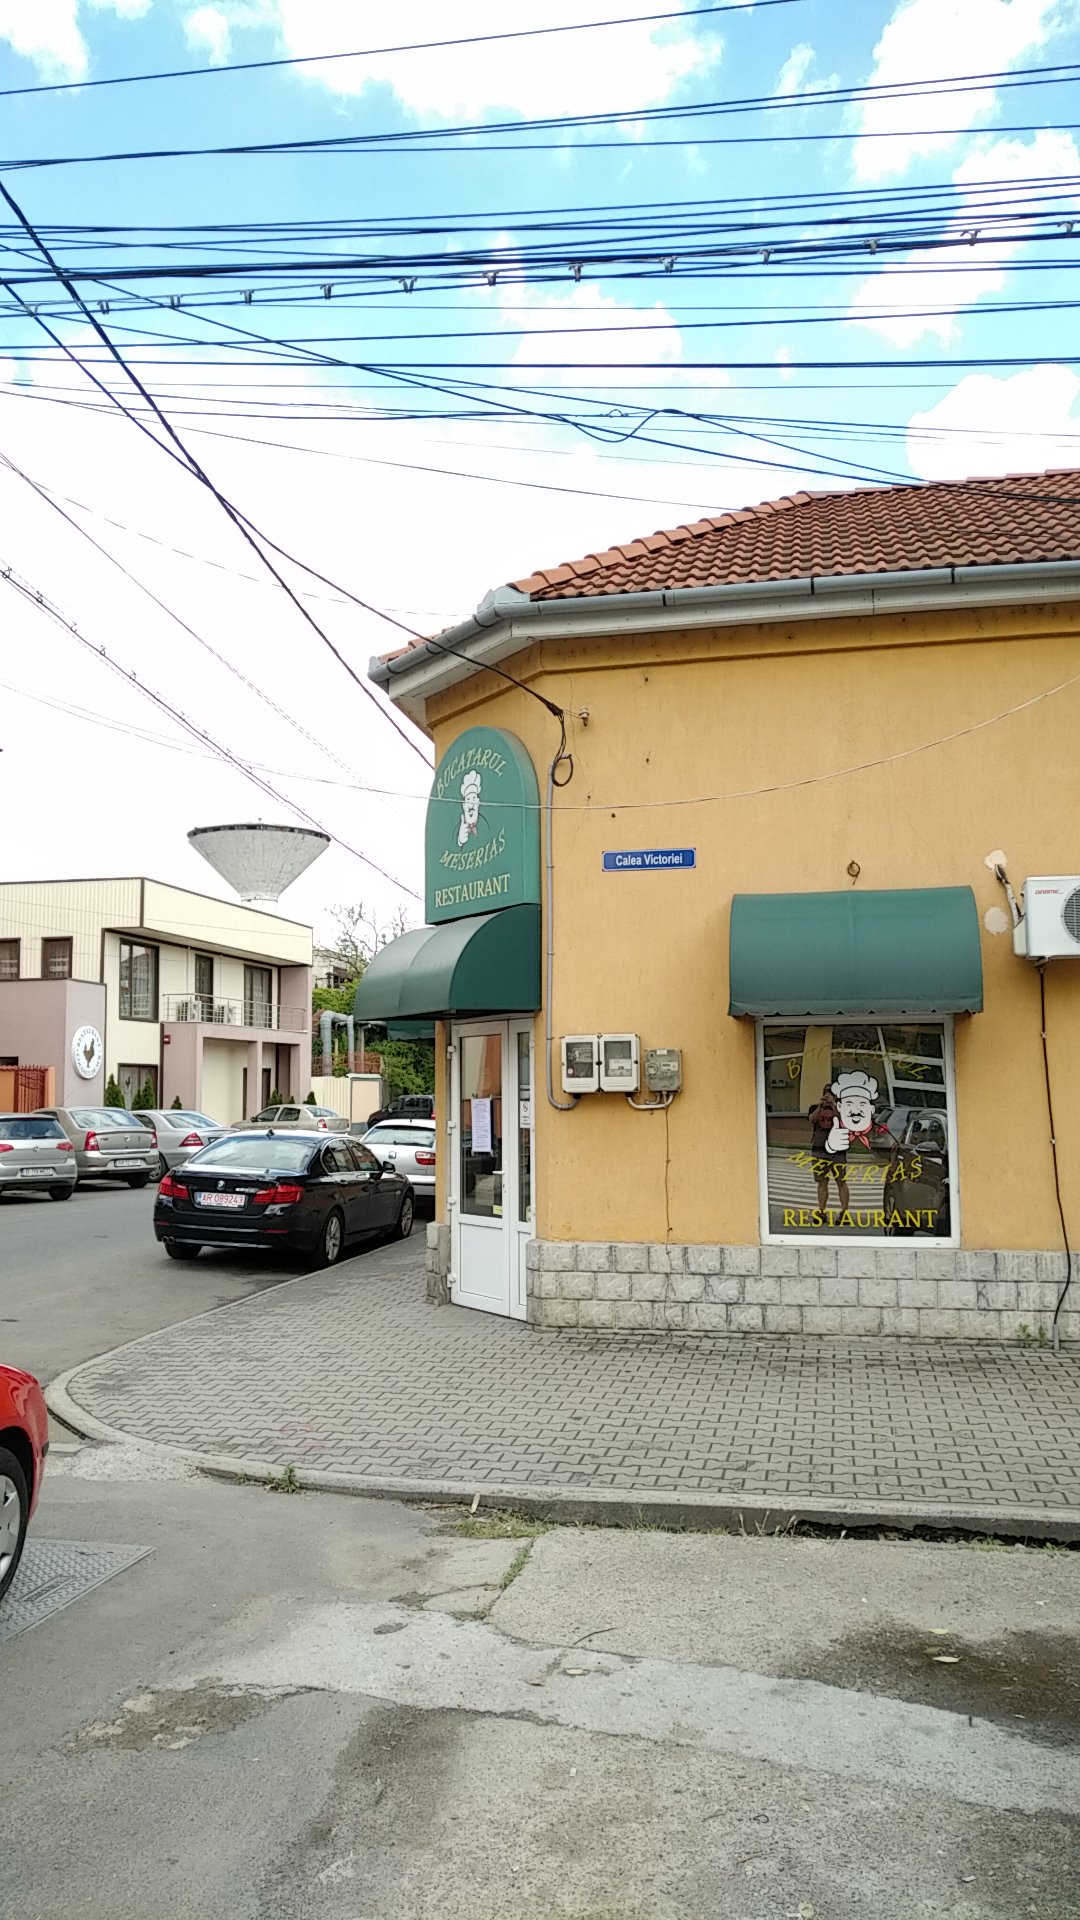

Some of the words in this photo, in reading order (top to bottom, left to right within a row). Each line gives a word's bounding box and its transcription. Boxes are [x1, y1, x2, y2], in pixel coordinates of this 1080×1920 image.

[437, 747, 507, 800] BUCATARUL
[440, 827, 506, 871] MESERIAS
[615, 854, 642, 866] Calea
[643, 852, 683, 865] Victoriei
[434, 873, 511, 908] RESTAURANT
[788, 1151, 923, 1184] MESERIAS
[202, 1193, 213, 1202] AR
[782, 1209, 938, 1228] RESTAURANT
